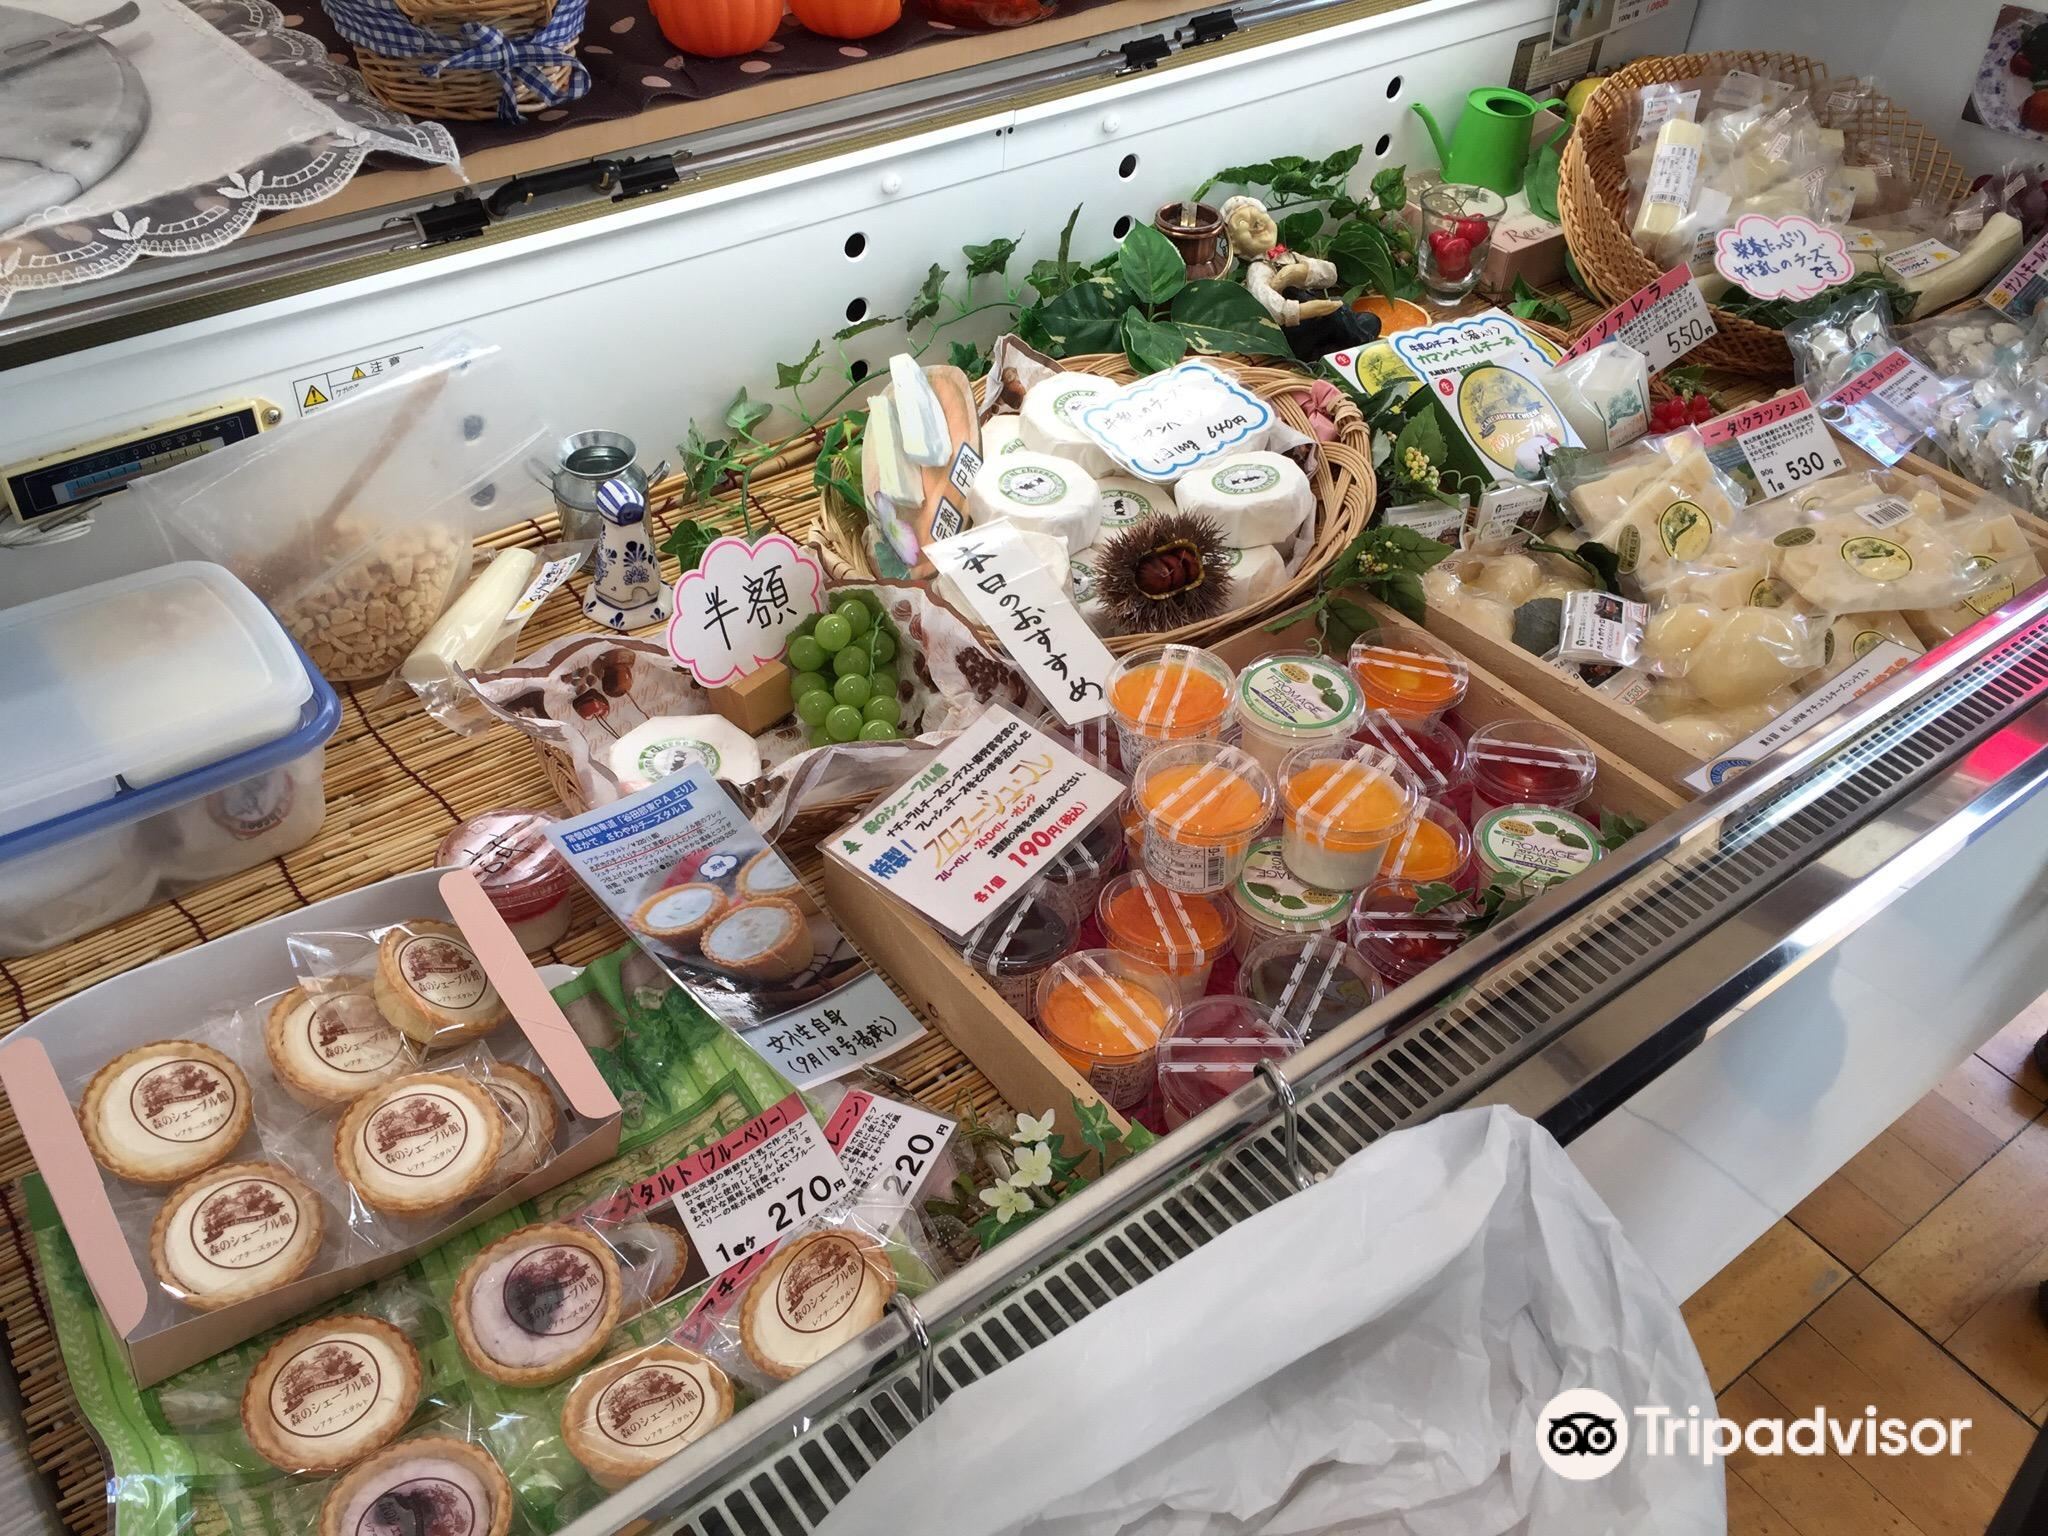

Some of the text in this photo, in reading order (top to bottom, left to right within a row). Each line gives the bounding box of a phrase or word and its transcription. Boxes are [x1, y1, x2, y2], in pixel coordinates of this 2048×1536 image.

[1206, 415, 1248, 440] 640円
[1785, 449, 1825, 482] 530
[703, 565, 797, 650] 半額
[954, 542, 1103, 701] 本日のおすすめ
[1262, 688, 1300, 714] FRAIS
[1267, 674, 1324, 717] FROMAGE
[1502, 838, 1578, 860] FROMAGE
[1513, 851, 1560, 868] FRAIS
[766, 1008, 848, 1053] 女性自身
[152, 1091, 230, 1131] 森のシェーブル館
[934, 1121, 949, 1137] 円
[385, 1122, 462, 1166] 森のシェーブル館
[680, 1121, 804, 1200] 地元茨城の新鮮な牛乳で作ったフ
[209, 1212, 294, 1257] 森のシェーブル館
[290, 1371, 375, 1427] 森のシェーブル館
[620, 1389, 699, 1441] 森のシェーブル館
